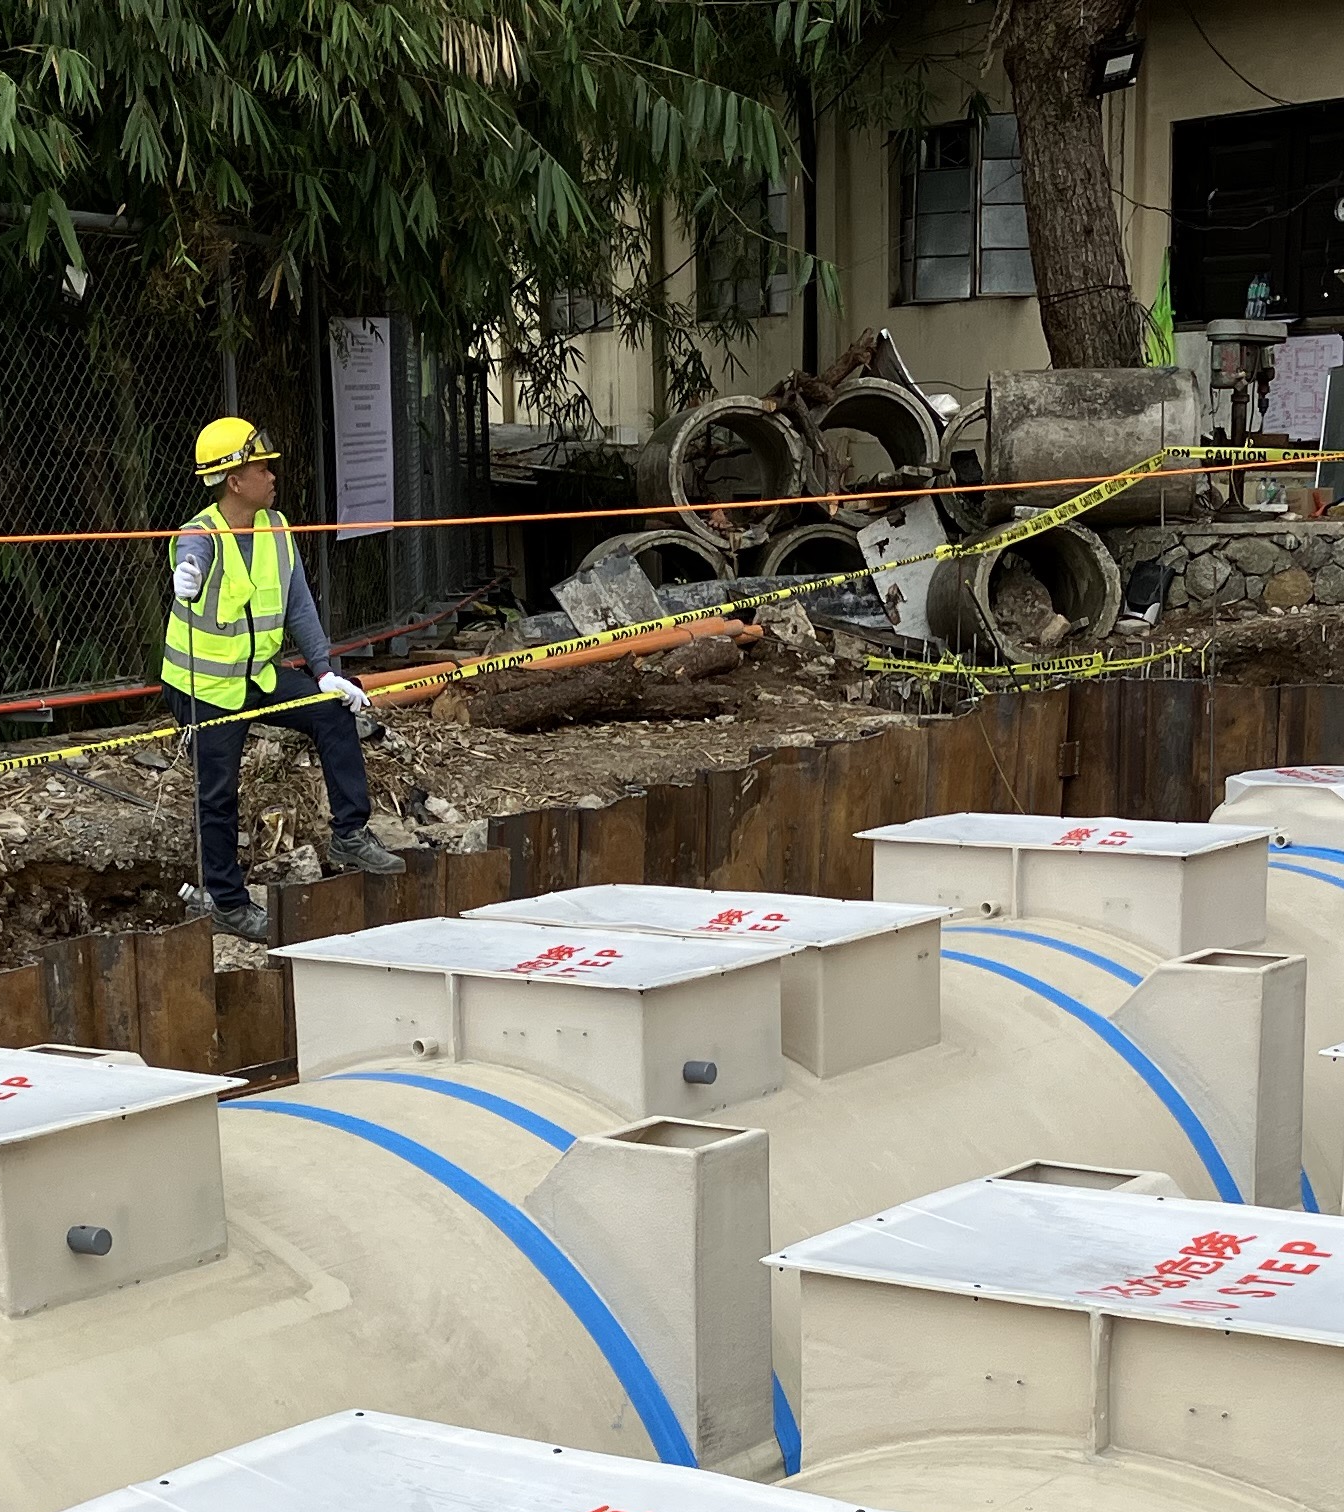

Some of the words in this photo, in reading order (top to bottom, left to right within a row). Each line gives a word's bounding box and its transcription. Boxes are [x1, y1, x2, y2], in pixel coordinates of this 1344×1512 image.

[1205, 449, 1267, 462] CAUTION
[477, 653, 533, 677] CAUTION
[546, 637, 600, 659] CAUTION
[612, 621, 663, 642] CAUTION
[673, 607, 723, 627] CAUTION
[1031, 656, 1094, 672] CAUTION
[1217, 1241, 1334, 1298] STEP
